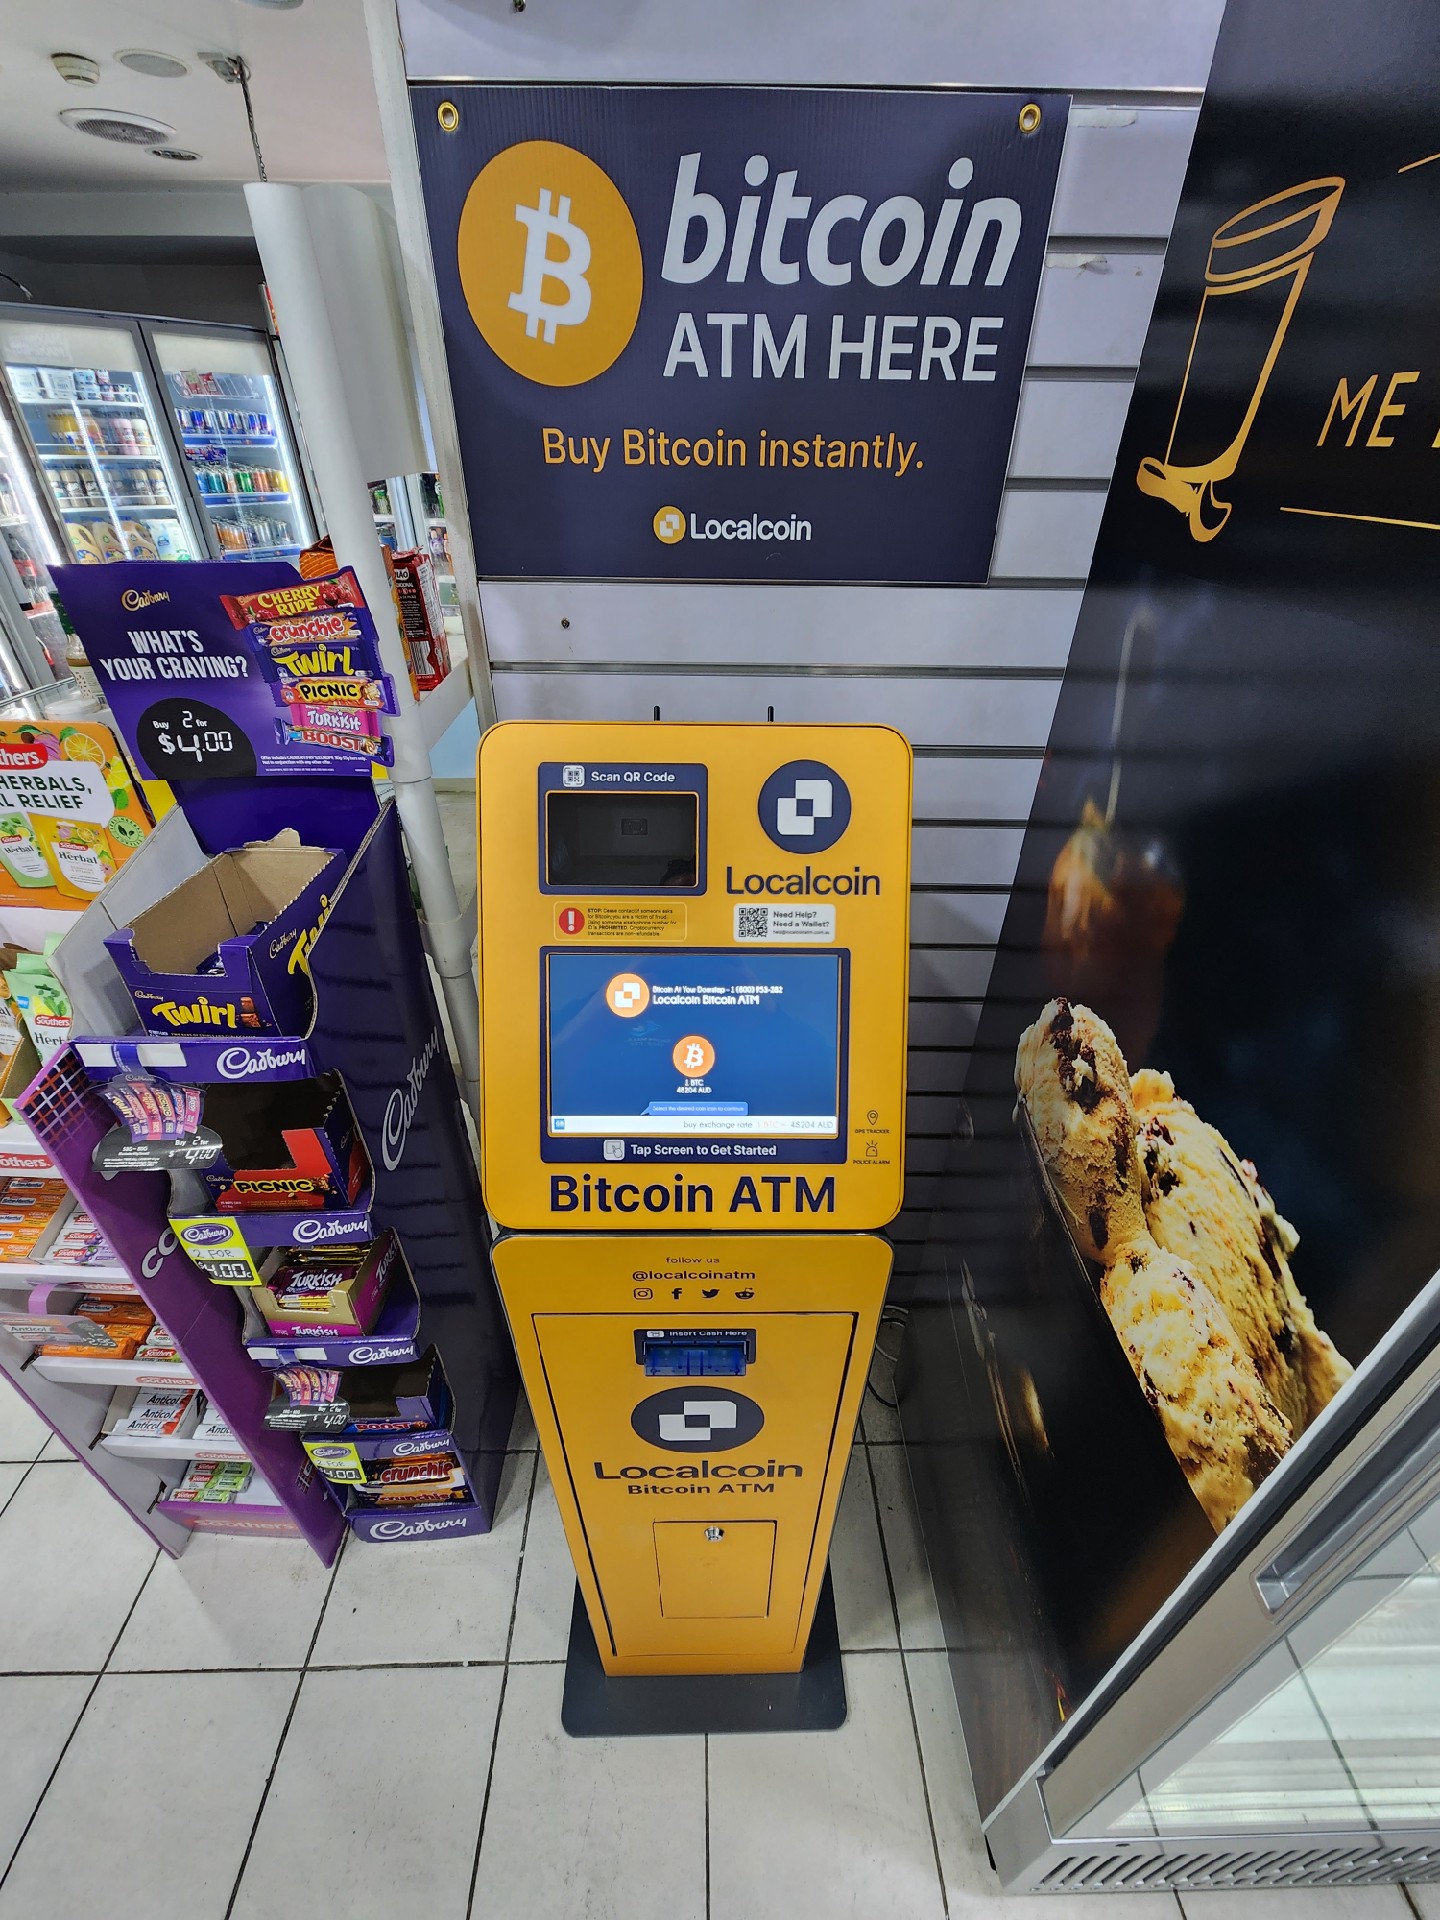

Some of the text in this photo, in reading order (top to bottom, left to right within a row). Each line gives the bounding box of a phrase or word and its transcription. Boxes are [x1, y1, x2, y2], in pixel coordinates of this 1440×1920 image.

[660, 151, 1022, 286] bitcoin
[663, 312, 1004, 381] ATM HERE
[1317, 371, 1420, 447] ME
[542, 427, 925, 477] Buy Bitcoin instantly.
[690, 512, 811, 542] Localcoin
[121, 589, 170, 611] Cadbury
[257, 585, 321, 608] CHERRY
[275, 599, 318, 616] RIPE
[270, 615, 345, 642] crunchie
[127, 630, 204, 653] WHAT'S
[99, 656, 249, 680] YOUR CRAVING?
[300, 684, 358, 700] PICNIC
[152, 711, 207, 729] Buy 2 for
[158, 731, 233, 762] $4.00
[303, 731, 361, 751] BOOST
[591, 771, 675, 784] Scan QR Code
[16, 794, 84, 809] RELIEF
[59, 851, 98, 864] Herbal
[726, 866, 881, 896] Localcoin
[795, 911, 817, 920] Help?
[269, 928, 297, 959] Cadbury
[134, 990, 164, 1002] Cadbury
[652, 985, 673, 993] Bitcoin
[652, 995, 760, 1005] Localcoin Bitcoin ATM
[35, 1017, 70, 1026] Soothers
[151, 996, 237, 1029] Twirl
[216, 1047, 306, 1079] Cadbury
[381, 1025, 440, 1171] Cadbury
[683, 1120, 697, 1130] buy
[699, 1120, 735, 1130] exchange
[737, 1120, 753, 1129] rate
[817, 1120, 834, 1129] AUD
[192, 1136, 201, 1145] 2
[630, 1144, 777, 1157] Tap Screen to Get Started
[234, 1179, 314, 1194] PICNIC
[550, 1173, 835, 1212] Bitcoin ATM
[182, 1226, 231, 1243] Cadbury
[292, 1218, 369, 1243] Cadbury
[193, 1248, 235, 1258] 2 FOR
[666, 1256, 700, 1264] follow
[290, 1268, 343, 1289] TURKISH
[632, 1269, 756, 1281] @localcoinatm
[145, 1349, 175, 1357] Soothers
[348, 1345, 414, 1365] Cadbury
[141, 1377, 193, 1385] Soothers
[147, 1394, 181, 1406] Anticol
[141, 1409, 174, 1419] Anticol
[324, 1415, 347, 1428] 4.00
[127, 1420, 162, 1430] Anticol
[392, 1438, 450, 1456] Cadbury
[380, 1461, 454, 1484] crunchie
[593, 1460, 803, 1480] Localcoin
[627, 1483, 774, 1495] Bitcoin ATM
[370, 1518, 467, 1540] Cadbury
